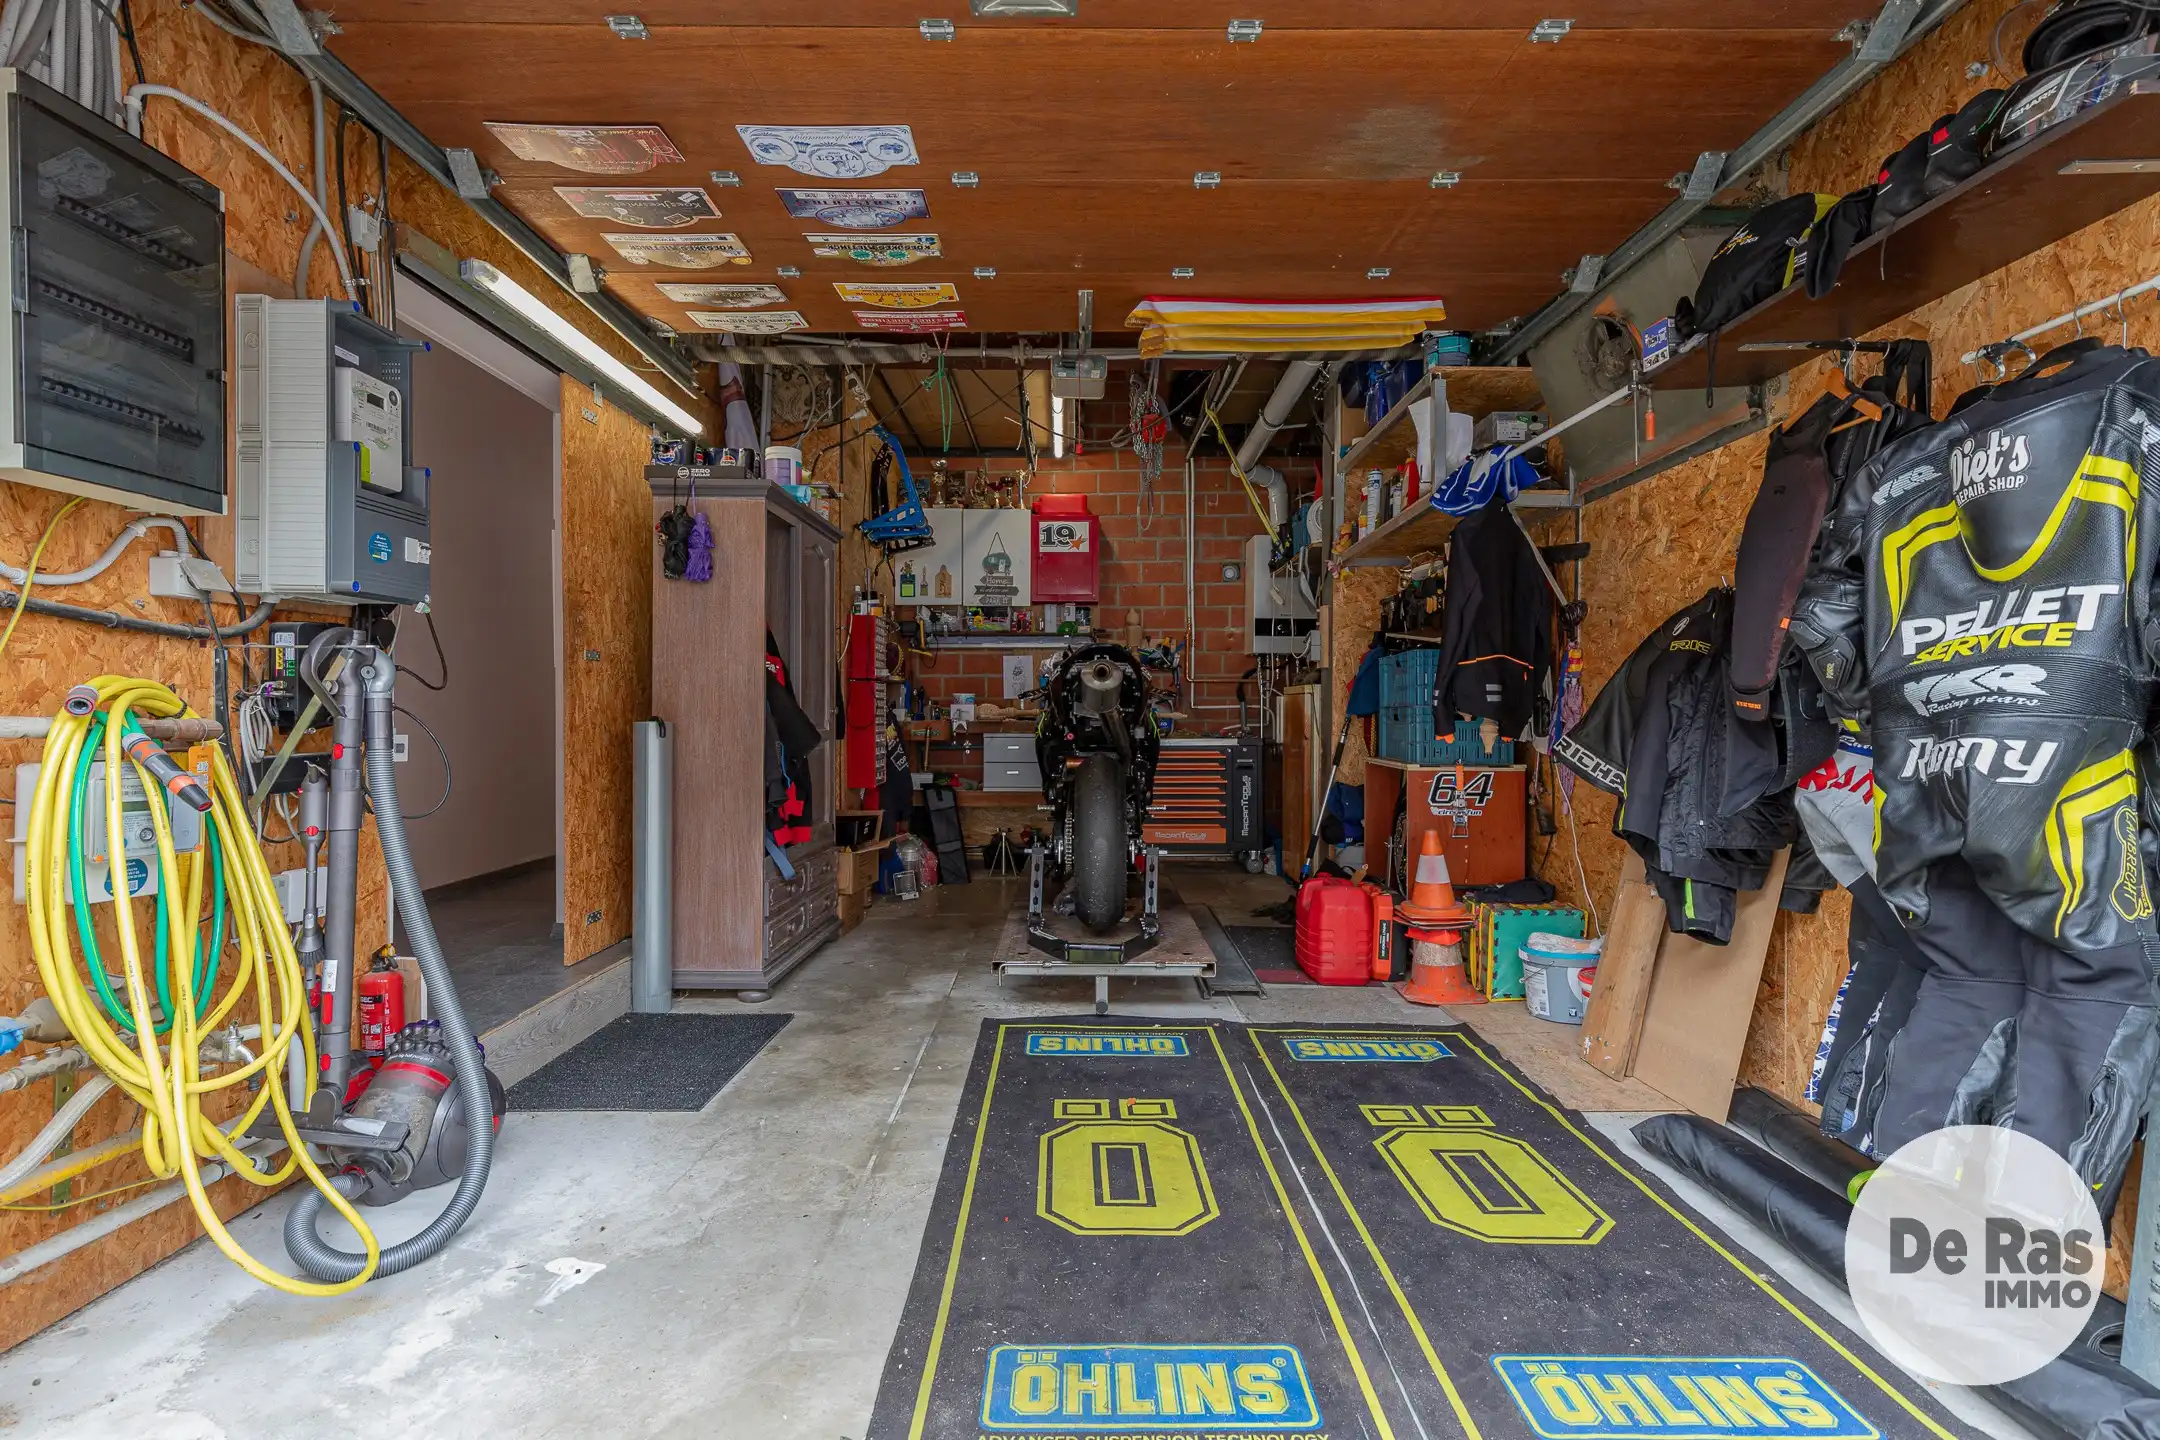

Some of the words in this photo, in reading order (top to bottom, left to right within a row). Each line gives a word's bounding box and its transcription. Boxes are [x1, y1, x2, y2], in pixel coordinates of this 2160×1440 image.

[2010, 85, 2059, 120] SHARK
[1950, 428, 2032, 491] Diet's
[1955, 482, 1987, 507] REPAIR
[1988, 474, 2027, 493] SHOP
[1040, 524, 1076, 548] 19
[1900, 585, 2120, 656] PELLET
[1908, 621, 2078, 666] SERVICE
[1926, 698, 1969, 715] Racing
[1553, 735, 1626, 793] RICHA
[1900, 737, 2060, 787] Ronny
[1428, 772, 1495, 807] 64
[2123, 809, 2139, 908] LAMBRECHT
[1038, 1036, 1176, 1055] ÖHLINS
[1295, 1042, 1441, 1060] ÖHLINS
[1009, 1351, 1289, 1416] ÖHLINS
[1522, 1362, 1838, 1429] ÖHLINS
